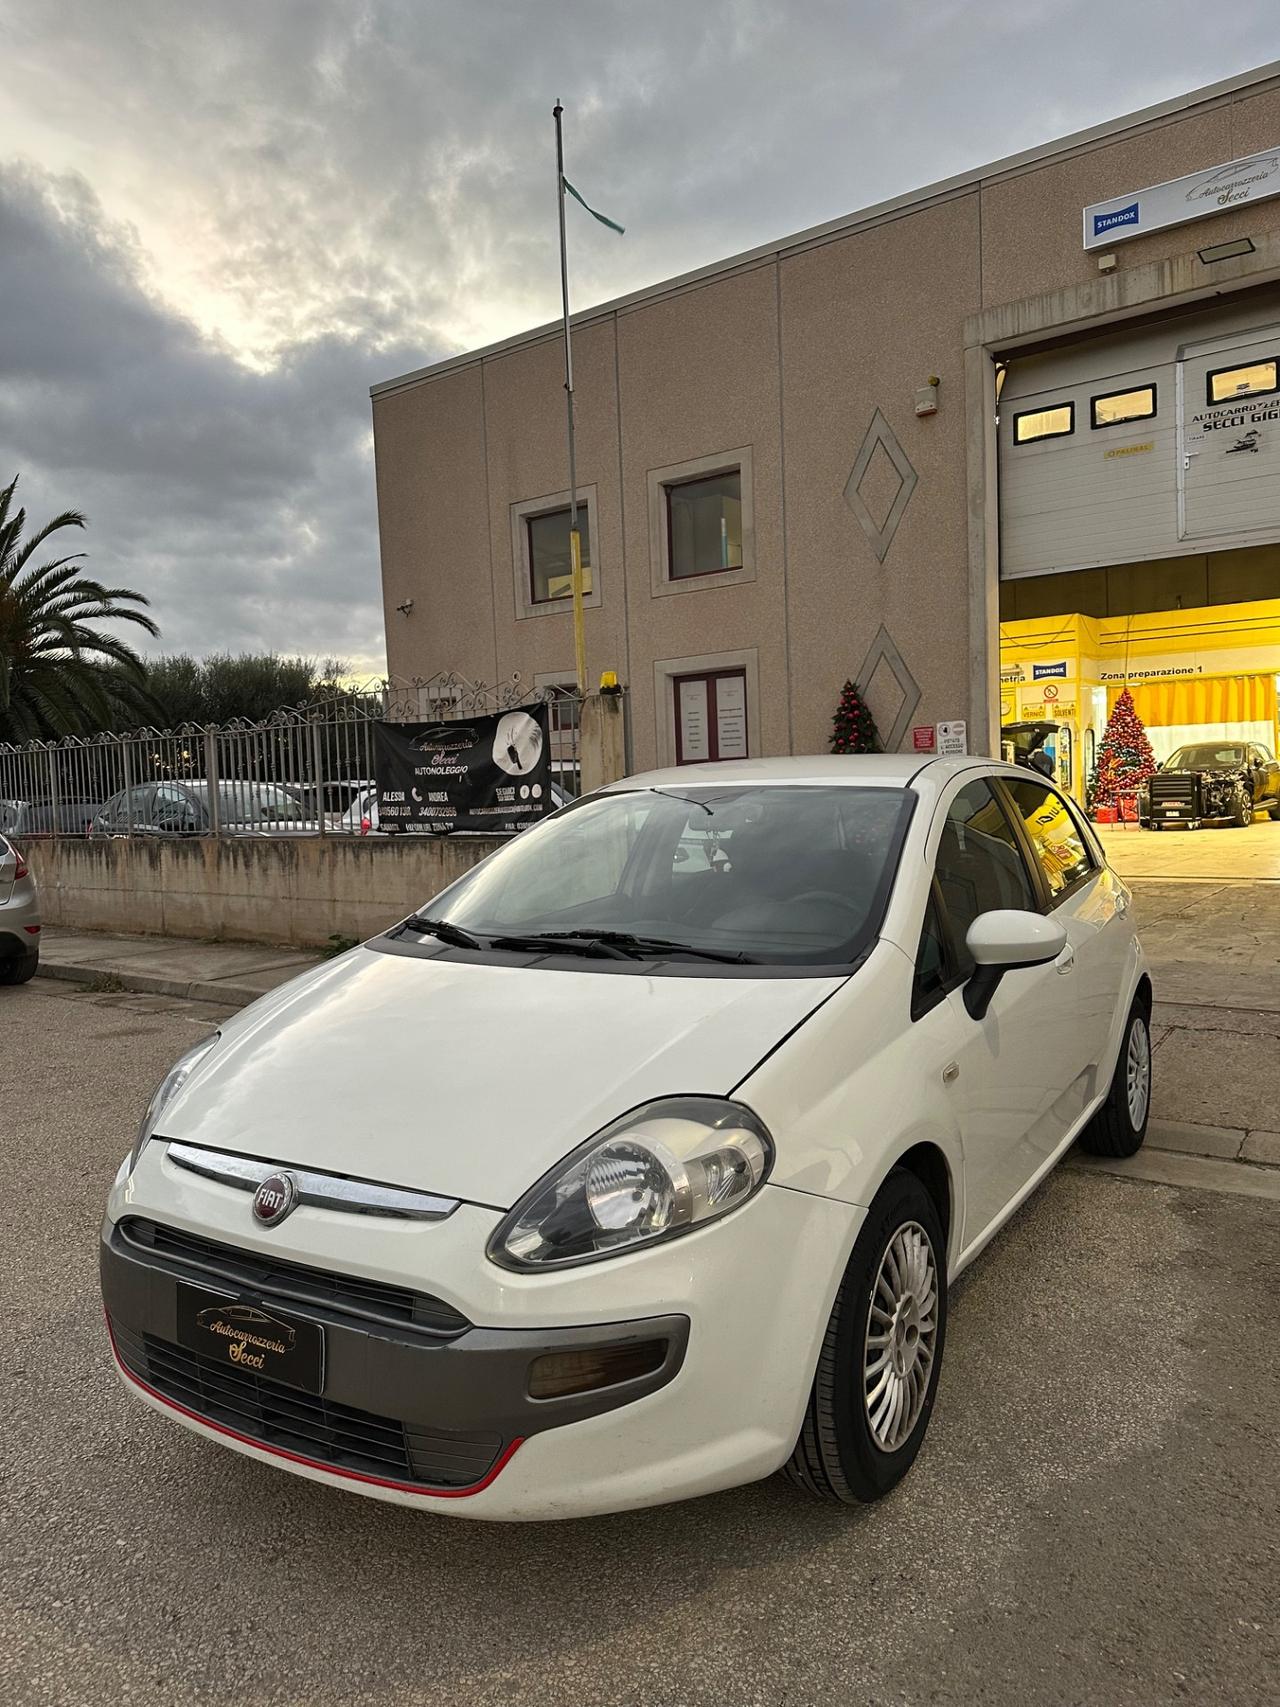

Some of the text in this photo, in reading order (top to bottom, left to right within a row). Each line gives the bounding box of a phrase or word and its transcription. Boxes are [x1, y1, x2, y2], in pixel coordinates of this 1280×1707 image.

[1199, 171, 1269, 199] Autocarrozzeria
[1217, 188, 1250, 205] Secci
[1097, 212, 1135, 228] STANDOX
[1203, 409, 1280, 432] SECCI GIG
[1035, 667, 1064, 675] STANDOX
[1100, 665, 1203, 680] Zona preparazione 1
[415, 765, 468, 776] AUTONOLEGGIO
[259, 1188, 284, 1209] FIAT
[210, 1321, 286, 1353] Autocarrozzeria
[229, 1341, 265, 1369] Secci
